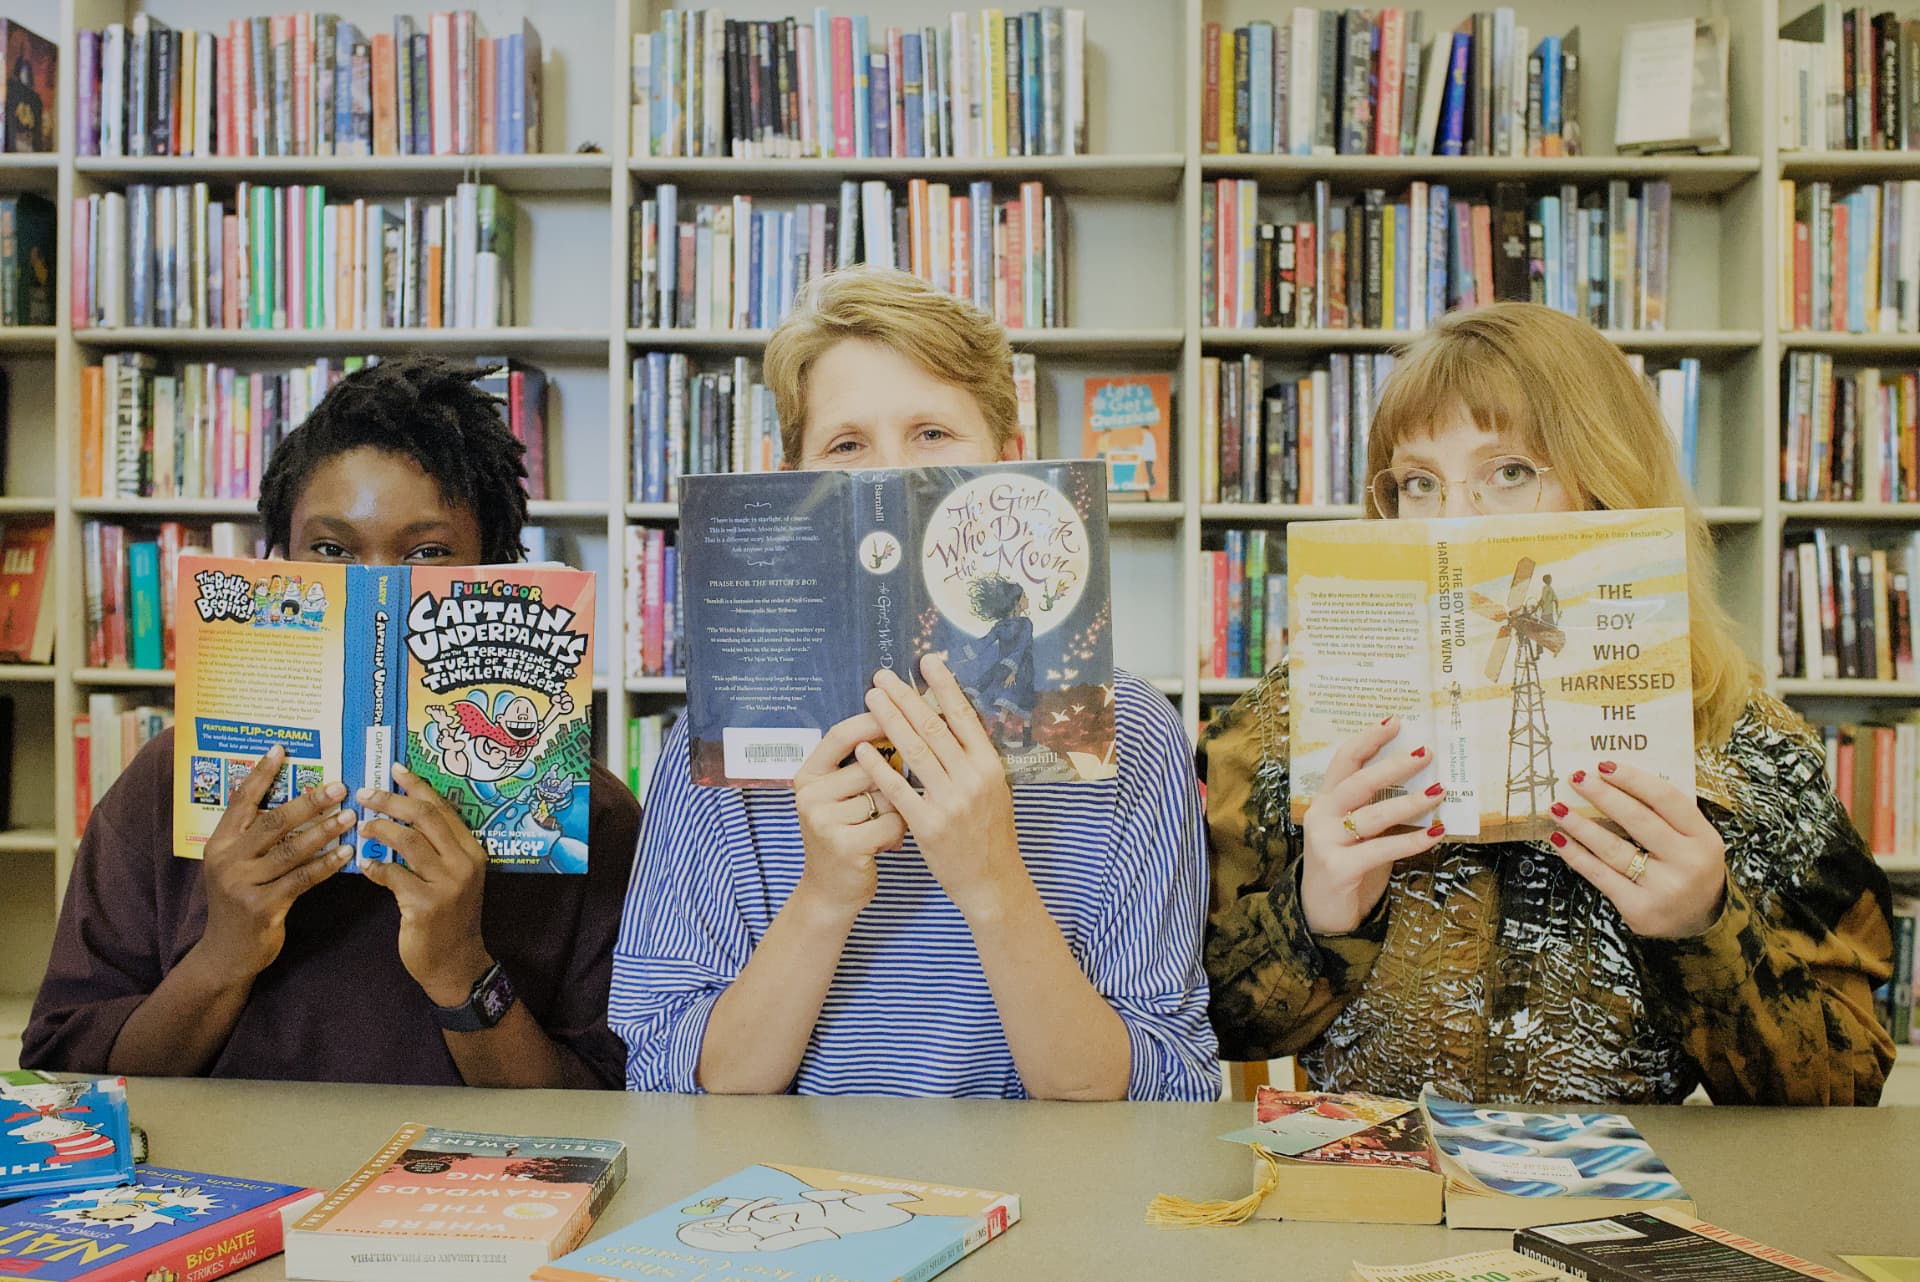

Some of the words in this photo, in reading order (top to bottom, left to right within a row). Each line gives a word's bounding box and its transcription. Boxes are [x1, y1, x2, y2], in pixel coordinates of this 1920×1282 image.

[874, 483, 885, 522] Barnhill
[946, 491, 984, 526] The
[989, 484, 1049, 524] Girl
[927, 521, 986, 569] Who
[944, 557, 977, 583] the
[982, 540, 1077, 584] Moon
[195, 570, 216, 586] The
[709, 580, 735, 588] PRAISE
[1437, 541, 1450, 611] HARNESSED
[1452, 567, 1463, 589] THE
[452, 582, 489, 598] FULL
[491, 580, 542, 601] COLOR
[1597, 584, 1633, 600] THE
[196, 598, 255, 622] Begins!
[1453, 592, 1464, 616] BOY
[408, 594, 573, 633] CAPTAIN
[1597, 613, 1636, 630] BOY
[1440, 614, 1451, 636] THE
[1454, 617, 1466, 648] WHO
[375, 610, 390, 668] CAPTAIN
[407, 622, 586, 664] UNDERPANTS
[463, 646, 552, 668] TERRIFYING
[1441, 638, 1453, 674] WIND
[1593, 643, 1640, 661] WHO
[427, 656, 481, 674] TURN
[484, 657, 499, 667] OF
[502, 657, 557, 681] TIPPY
[1560, 673, 1676, 692] HARNESSED
[1600, 705, 1636, 721] THE
[202, 724, 239, 733] FEATURING
[239, 726, 313, 741] FLIP-O-RAMA!
[375, 731, 384, 770] CAPTAIN
[1590, 734, 1648, 751] WIND
[1007, 751, 1058, 764] Barnhill
[509, 830, 537, 838] NOVEL
[486, 837, 545, 857] PILKEY
[490, 857, 515, 865] HONOR
[429, 1136, 524, 1151] OWENS
[532, 1141, 608, 1153] DELIA
[207, 1177, 274, 1192] Lincoln
[300, 1211, 323, 1228] THE
[323, 1168, 376, 1212] WORLDWIDE
[370, 1127, 417, 1170] SENSATION
[445, 1171, 534, 1183] SING
[374, 1184, 573, 1200] CRAWDADS
[418, 1202, 490, 1214] THE
[56, 1226, 116, 1239] STRIKES
[378, 1218, 508, 1233] WHERE
[217, 1228, 256, 1256] NATE
[185, 1262, 225, 1282] STRIKES
[228, 1247, 257, 1267] AGAIN
[350, 1254, 420, 1264] PHILADELPHIA
[422, 1254, 437, 1264] OF
[438, 1254, 481, 1264] LIBRARY
[482, 1254, 508, 1264] FREE
[1511, 1268, 1543, 1279] THE
